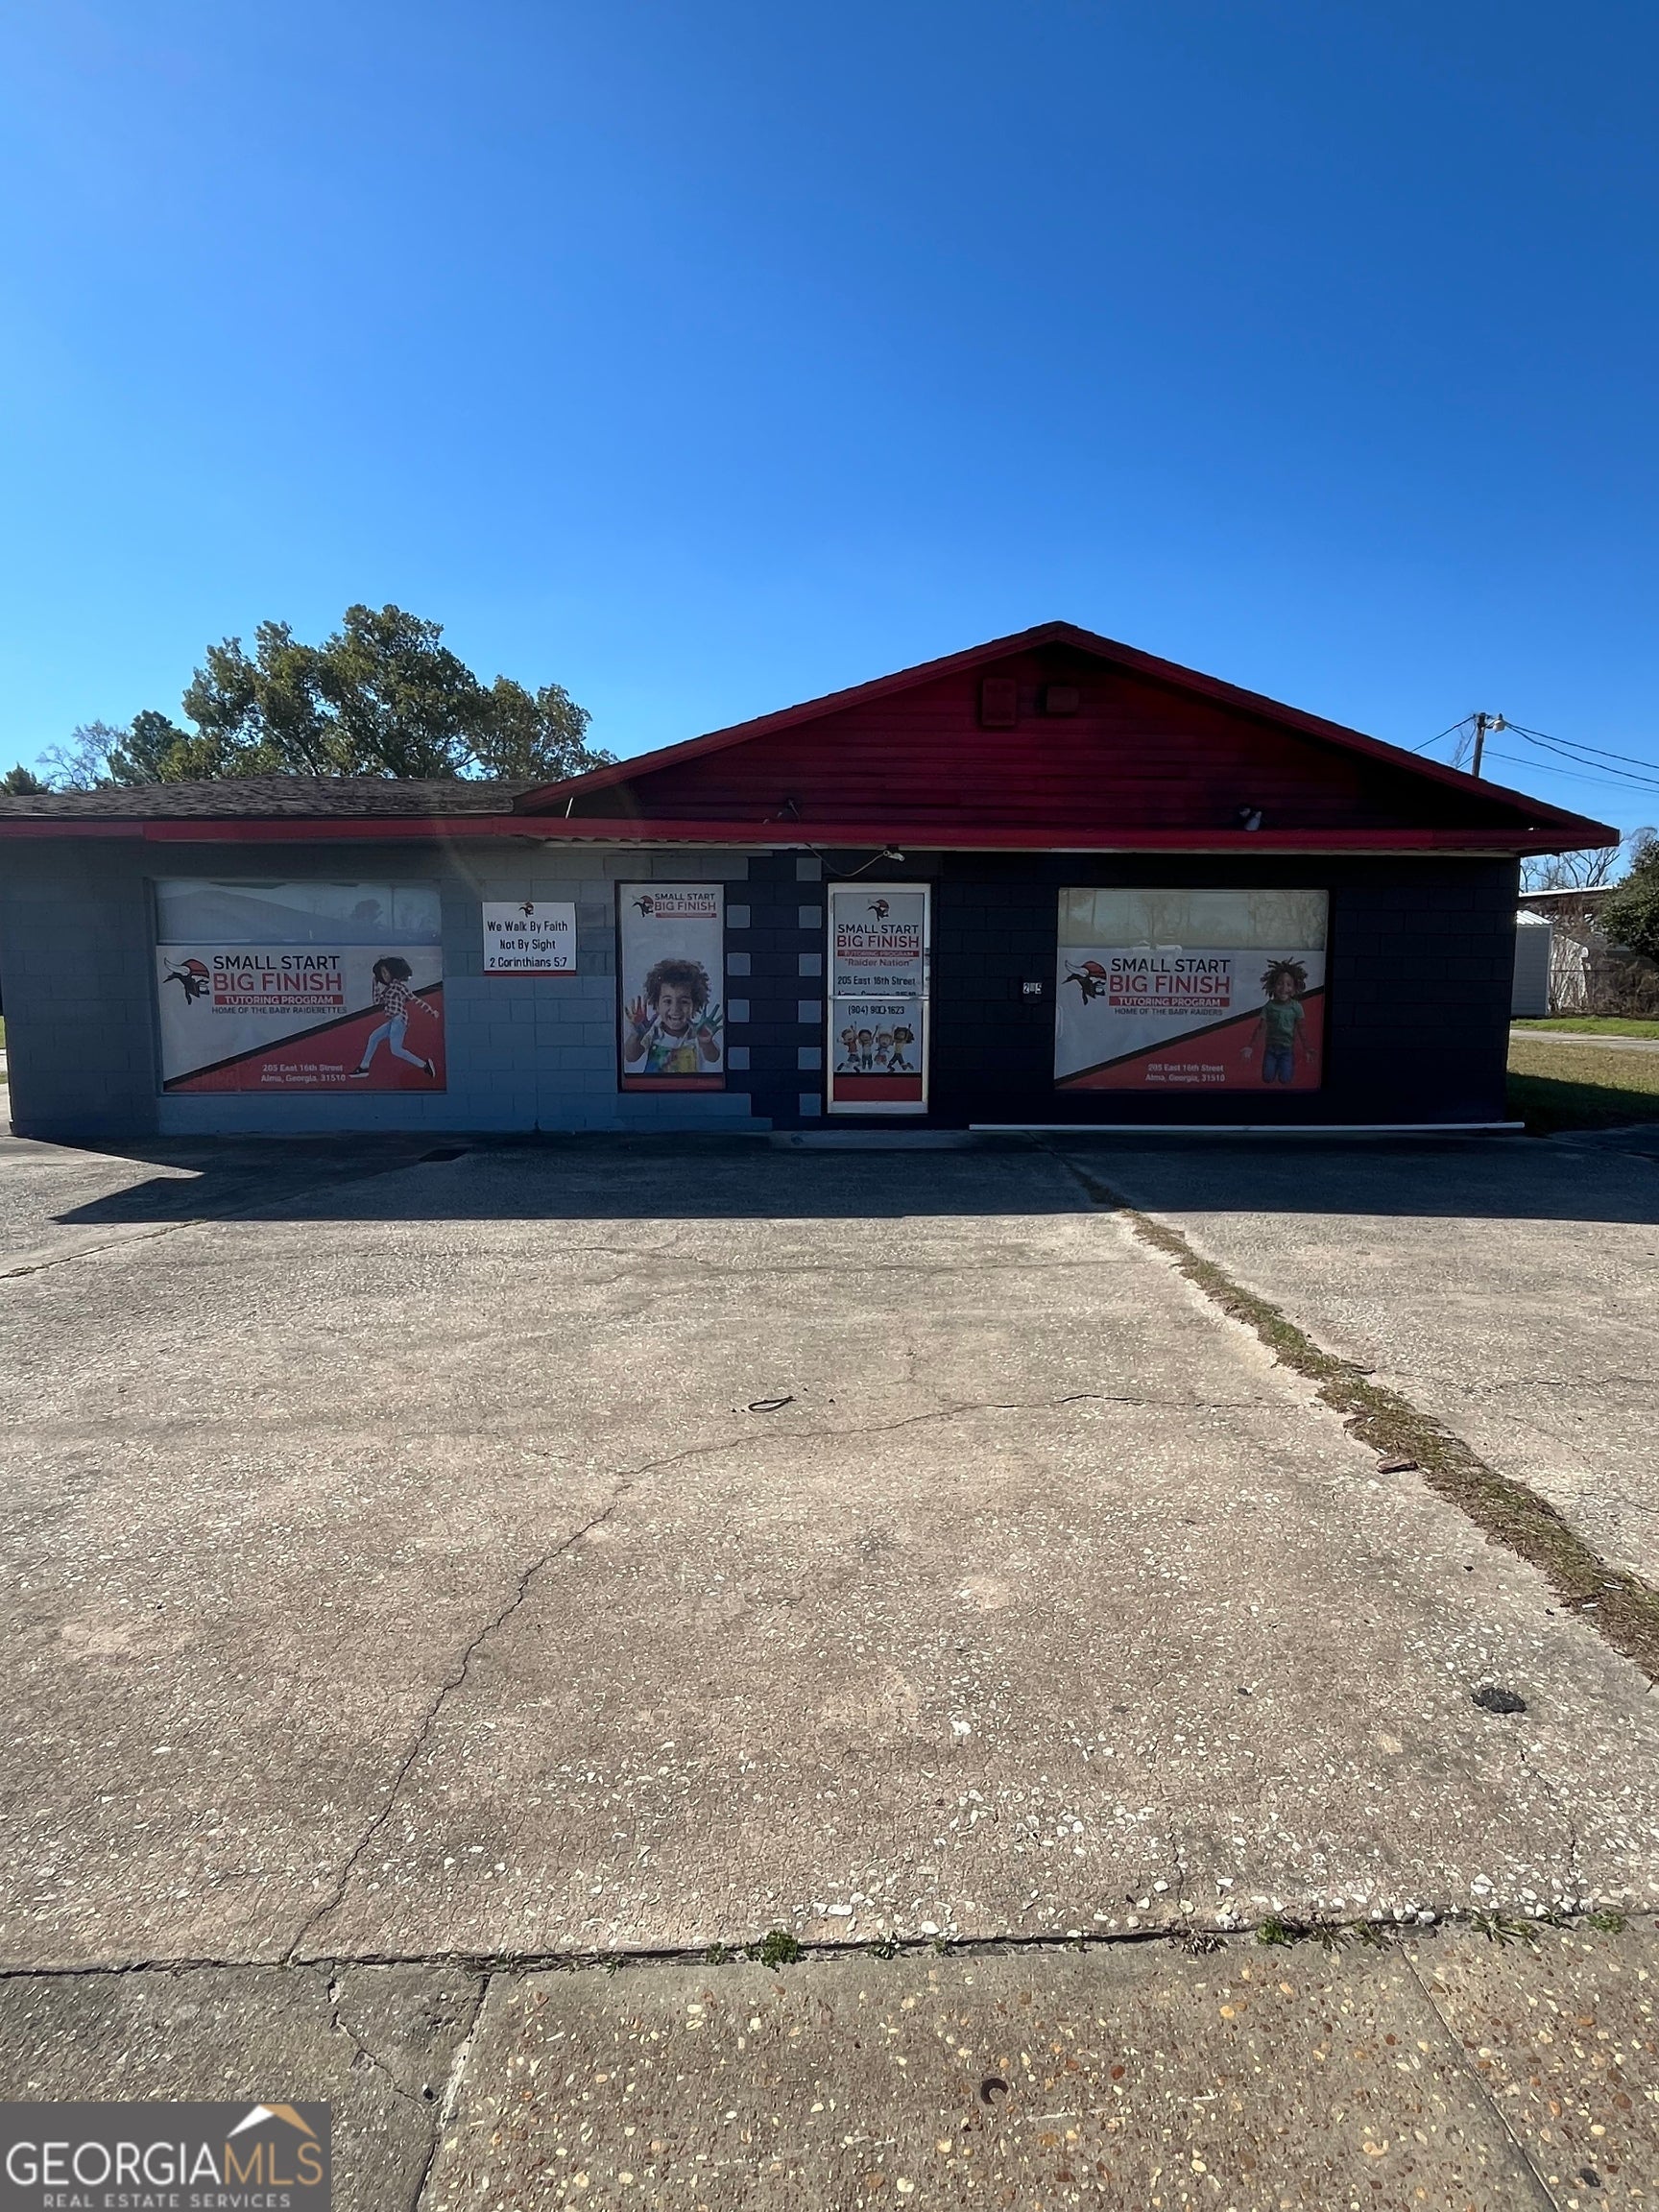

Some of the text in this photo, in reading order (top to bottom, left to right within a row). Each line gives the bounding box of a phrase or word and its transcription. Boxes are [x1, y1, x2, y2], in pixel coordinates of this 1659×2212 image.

[654, 902, 716, 911] BIG FINISH
[487, 921, 568, 934] We Walk By Faith
[837, 924, 919, 934] SMALL START
[499, 939, 556, 952] Not By Sight
[837, 935, 919, 948] BIG FINISH
[213, 955, 341, 970] SMALL START
[490, 957, 567, 968] 2 Corinthians 5:7
[1111, 958, 1231, 973] SMALL START
[213, 973, 342, 992] BIG FINISH
[837, 975, 916, 986] 205 East 16th Street
[1109, 974, 1230, 994] BIG FINISH
[1022, 982, 1042, 994] 25
[225, 996, 334, 1005] TUTORING PROGRAM
[1118, 998, 1220, 1006] TUTORING PROGRAM
[269, 1006, 291, 1015] BABY
[293, 1006, 348, 1015] RAIDERETTES
[848, 1005, 869, 1016] (904)
[262, 1064, 344, 1072] 205 East 16th Street
[1164, 1064, 1181, 1072] East
[1182, 1064, 1199, 1072] 16th
[1201, 1064, 1224, 1072] Street
[261, 1074, 284, 1084] Alma,
